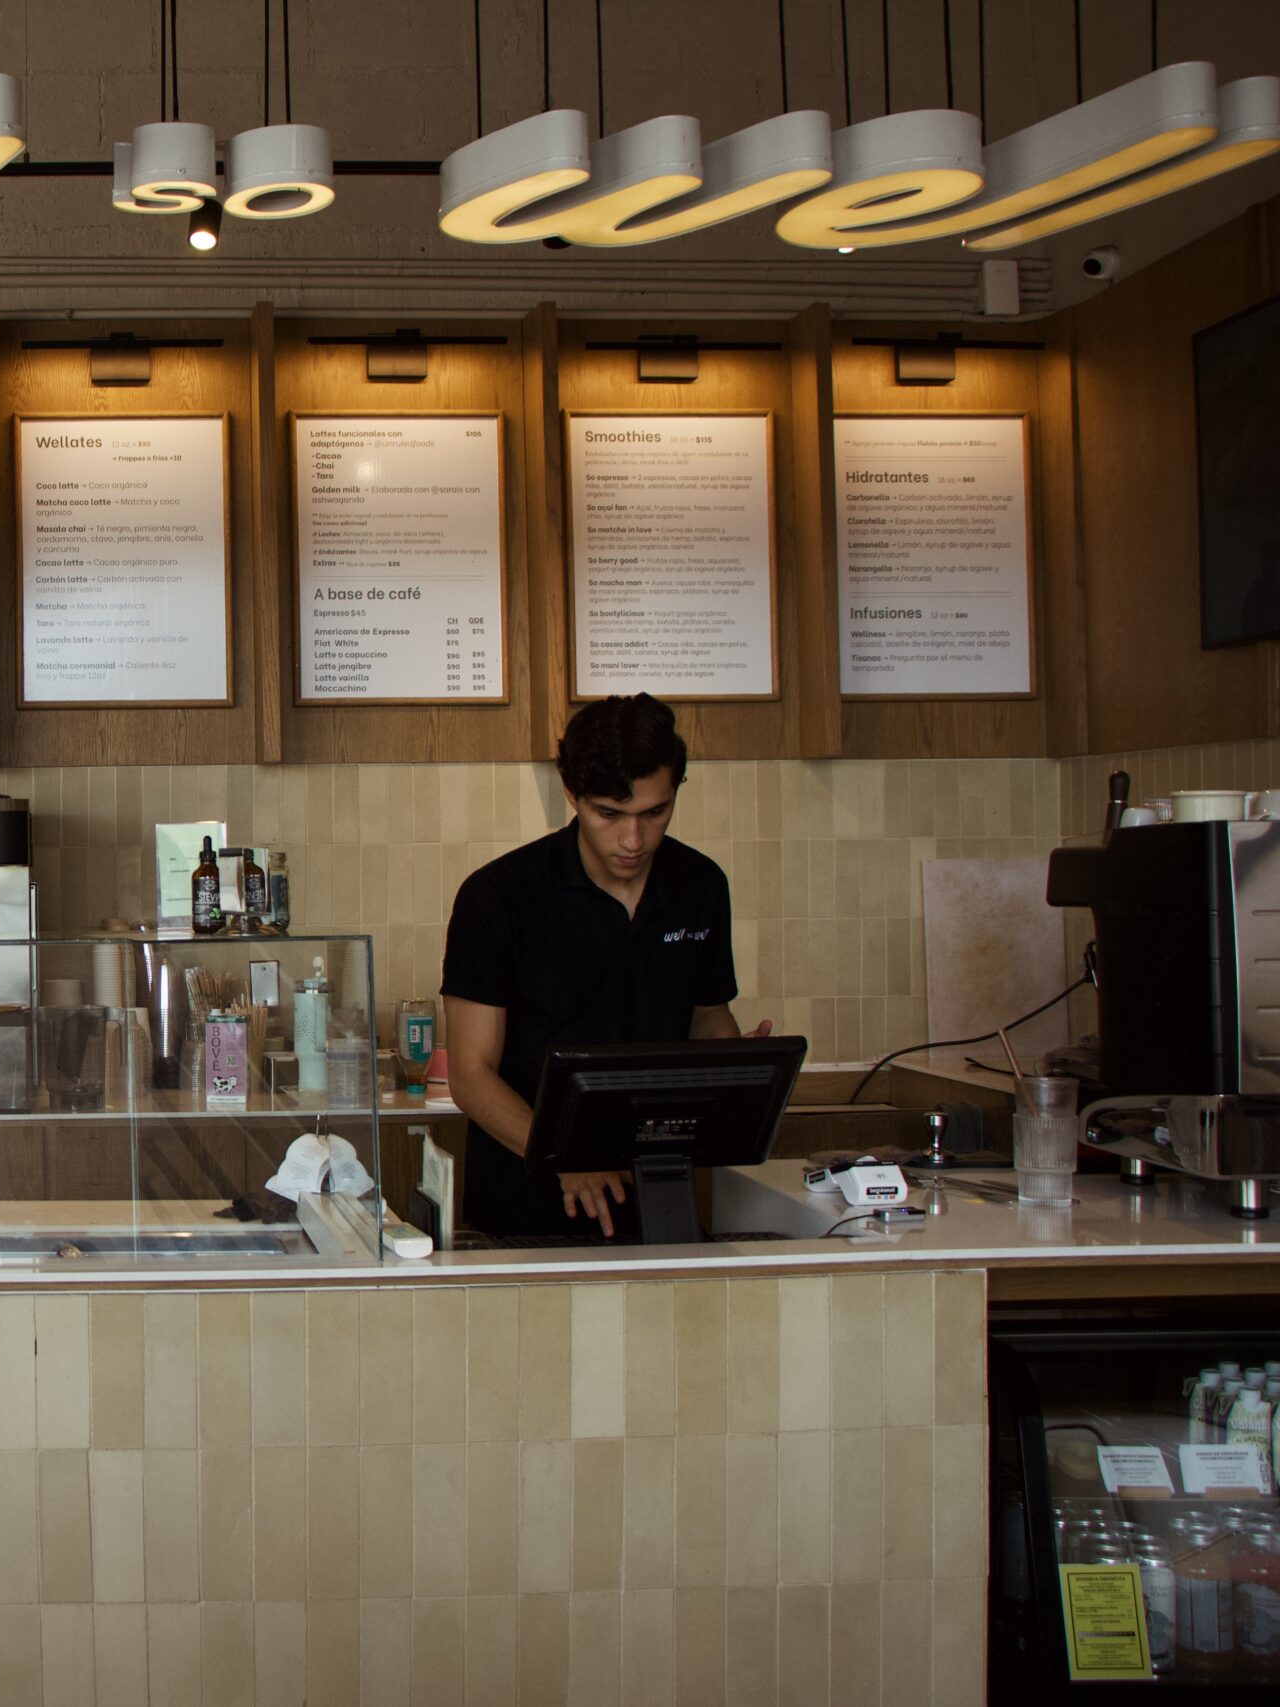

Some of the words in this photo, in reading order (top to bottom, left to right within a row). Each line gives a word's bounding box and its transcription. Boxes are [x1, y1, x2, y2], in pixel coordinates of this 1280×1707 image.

[113, 121, 335, 218] so
[439, 60, 1280, 250] well
[584, 429, 662, 444] Smoothies
[35, 435, 103, 449] Wellates
[310, 439, 365, 449] adaptógenos
[846, 470, 929, 484] Hidratantes
[111, 480, 148, 491] orgánico
[342, 486, 360, 494] milk
[371, 486, 413, 494] Elaborada
[36, 498, 68, 507] Matcha
[91, 498, 111, 506] latte
[120, 498, 152, 506] Matcha
[36, 508, 73, 518] orgánico
[69, 524, 86, 533] chai
[106, 526, 132, 534] negro,
[134, 524, 171, 534] pimienta
[172, 525, 198, 533] negra,
[36, 535, 89, 544] cardamomo,
[91, 534, 114, 543] clavo,
[175, 534, 204, 542] canela
[159, 559, 178, 568] puro
[599, 556, 618, 566] berry
[620, 556, 638, 566] good
[849, 565, 893, 573] Narangella
[35, 576, 66, 584] Carbón
[67, 575, 88, 583] latte
[129, 575, 164, 583] activado
[313, 588, 324, 600] A
[327, 587, 363, 600] base
[367, 587, 385, 600] de
[388, 586, 421, 600] café
[314, 610, 350, 618] Espresso
[600, 610, 645, 619] bootylicious
[850, 606, 923, 620] Infusiones
[344, 651, 388, 660] capuccino
[36, 662, 68, 670] Matcha
[69, 661, 116, 670] ceremonial
[337, 662, 372, 672] jengibre
[314, 684, 367, 693] Moccachino
[663, 928, 686, 943] well
[211, 1026, 222, 1072] BOVE
